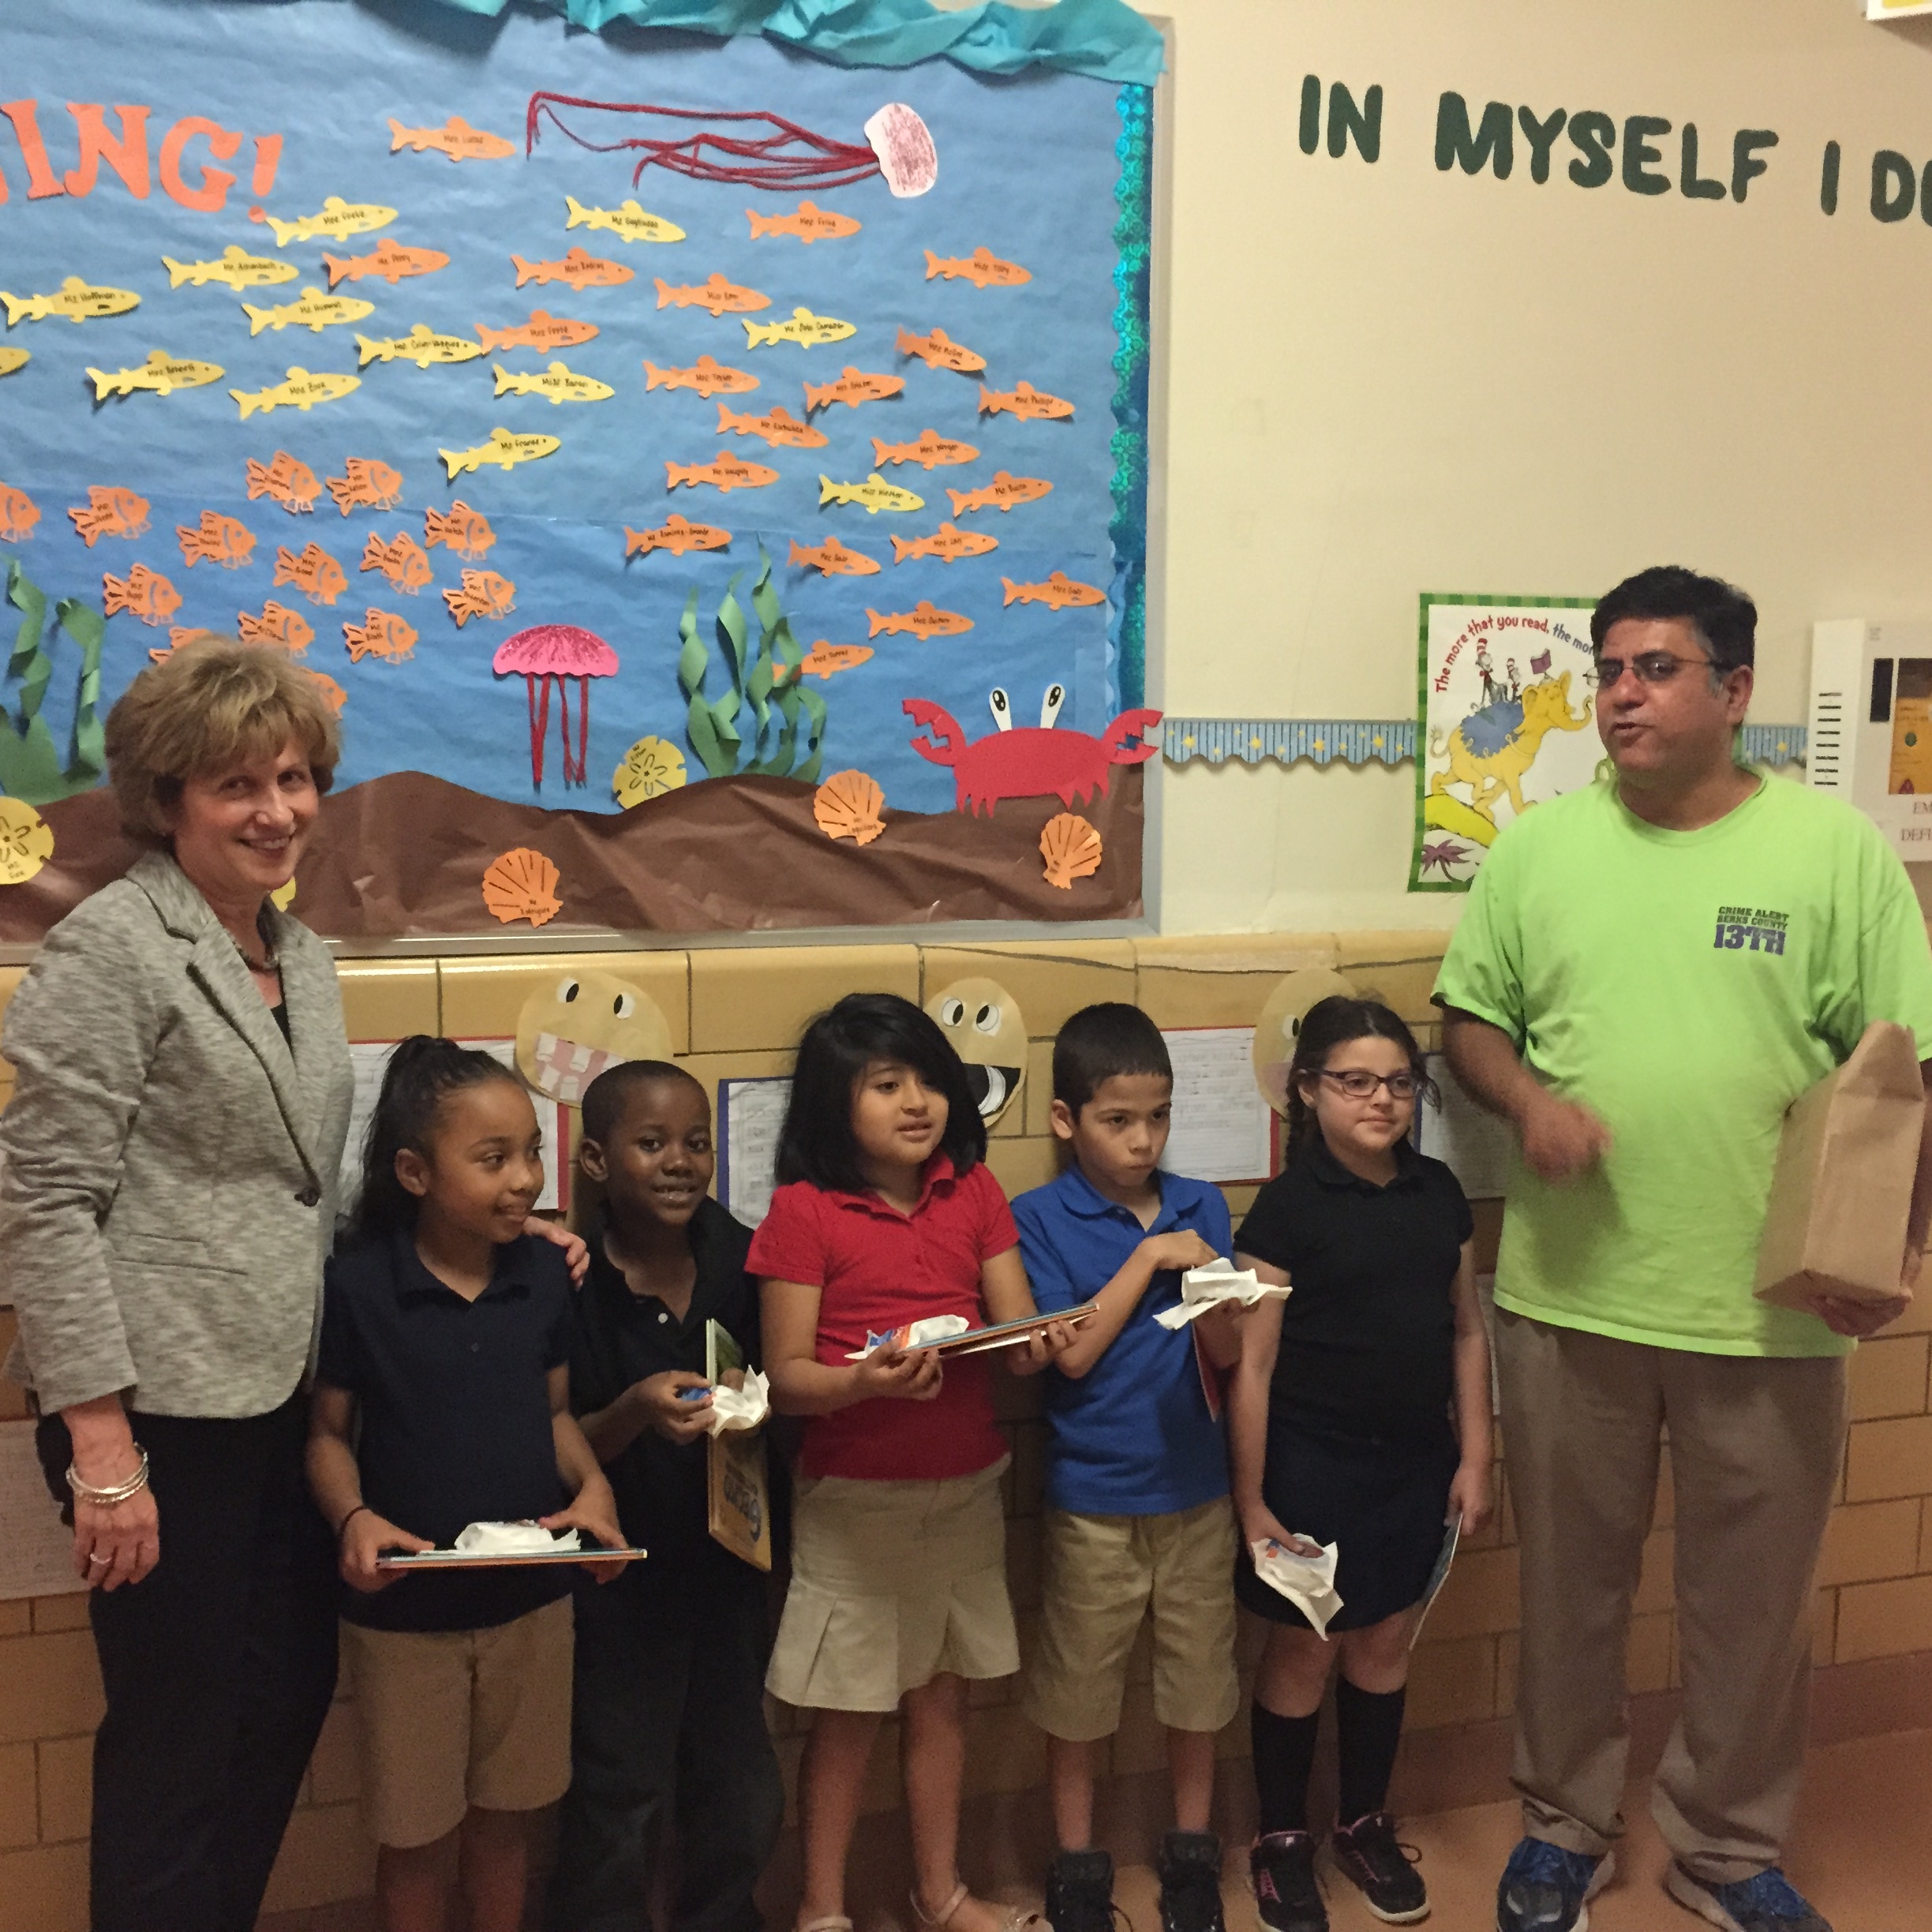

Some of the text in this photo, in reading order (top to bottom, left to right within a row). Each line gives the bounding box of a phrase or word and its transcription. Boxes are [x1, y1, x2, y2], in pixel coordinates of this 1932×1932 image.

[0, 98, 283, 223] ING!
[1297, 73, 1932, 228] IN MYSELF I D
[1434, 615, 1594, 693] The more that you read, the mor
[1713, 923, 1786, 956] 13TH
[1717, 915, 1788, 930] BERKS COUNTY
[1718, 906, 1789, 922] CRIME ALERT
